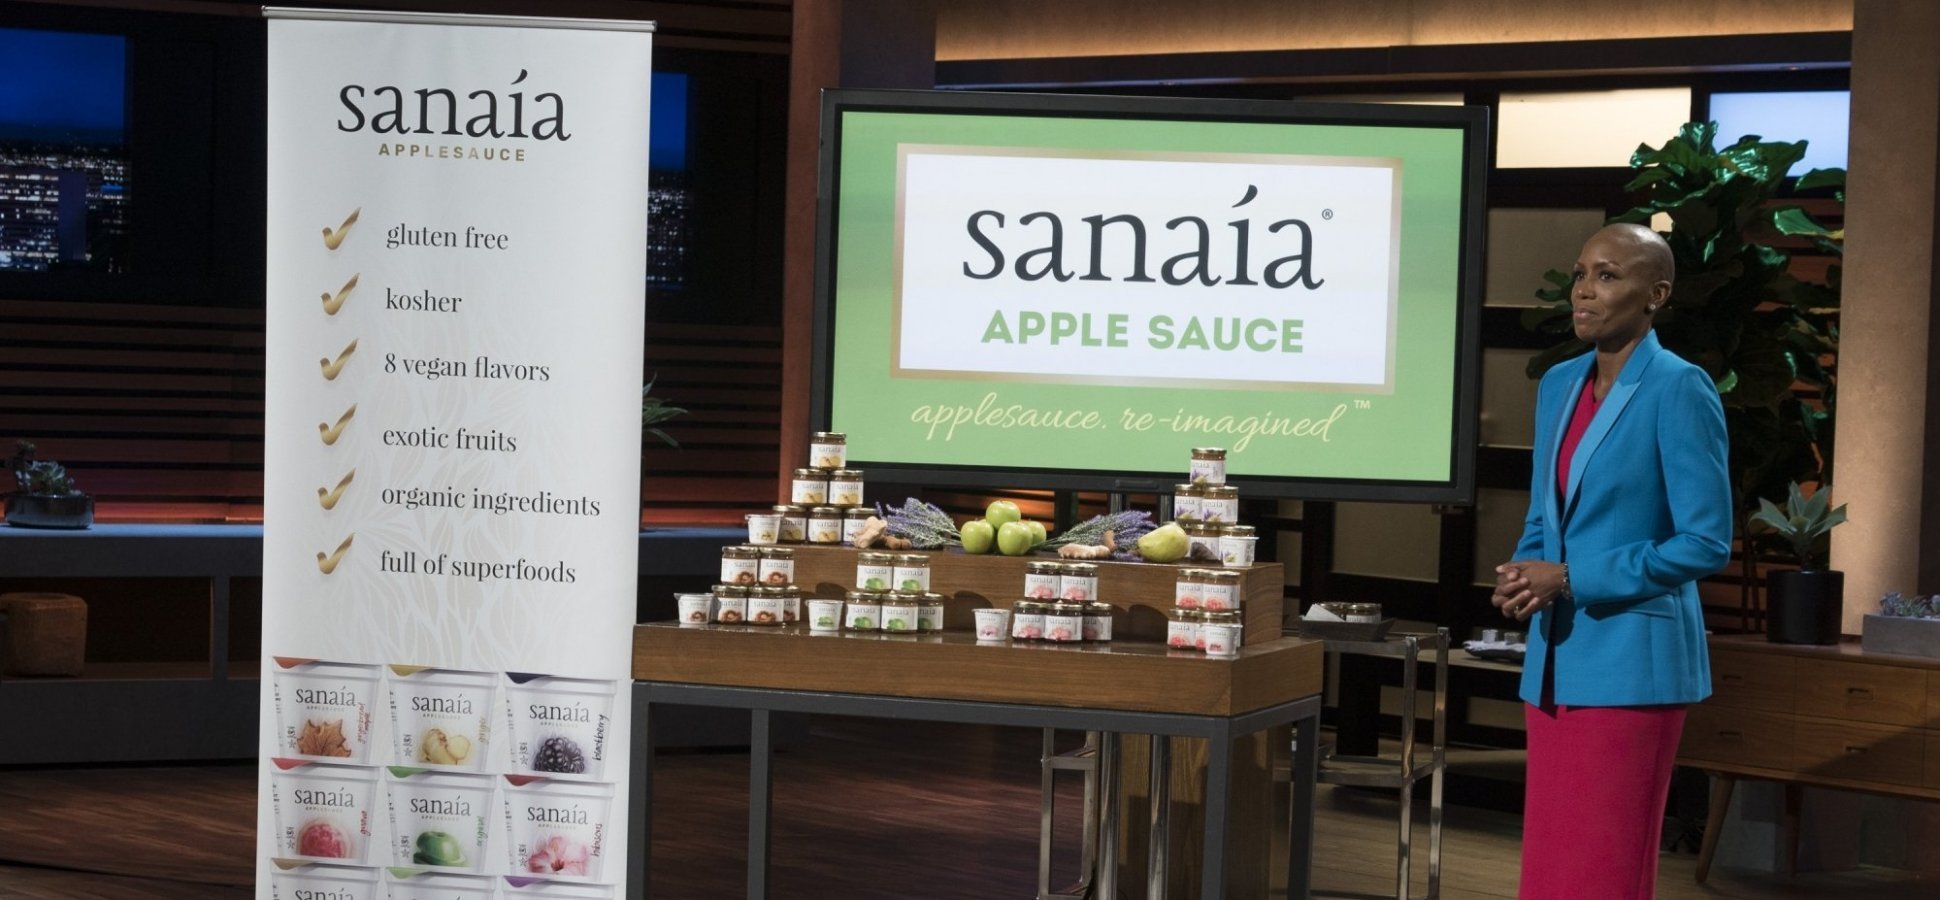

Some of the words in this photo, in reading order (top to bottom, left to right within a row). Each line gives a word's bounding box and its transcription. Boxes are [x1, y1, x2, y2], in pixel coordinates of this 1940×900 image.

[338, 69, 571, 141] sanaía
[378, 142, 525, 162] APPLESAUCE
[386, 222, 457, 249] gluten
[465, 226, 509, 250] free
[963, 185, 1325, 290] sanaía
[386, 287, 463, 313] kosher
[982, 310, 1128, 347] APPLE
[1148, 315, 1303, 352] SAUCE
[384, 353, 397, 373] 8
[402, 357, 467, 381] vegan
[474, 356, 550, 382] flavors
[911, 392, 1107, 440] applesauce.
[1120, 404, 1347, 452] re-imagined
[382, 426, 449, 449] exotic
[457, 427, 517, 452] fruits
[381, 485, 466, 510] organic
[472, 487, 600, 516] ingredients
[381, 550, 416, 574] full
[423, 553, 449, 575] of
[451, 558, 576, 583] superfoods
